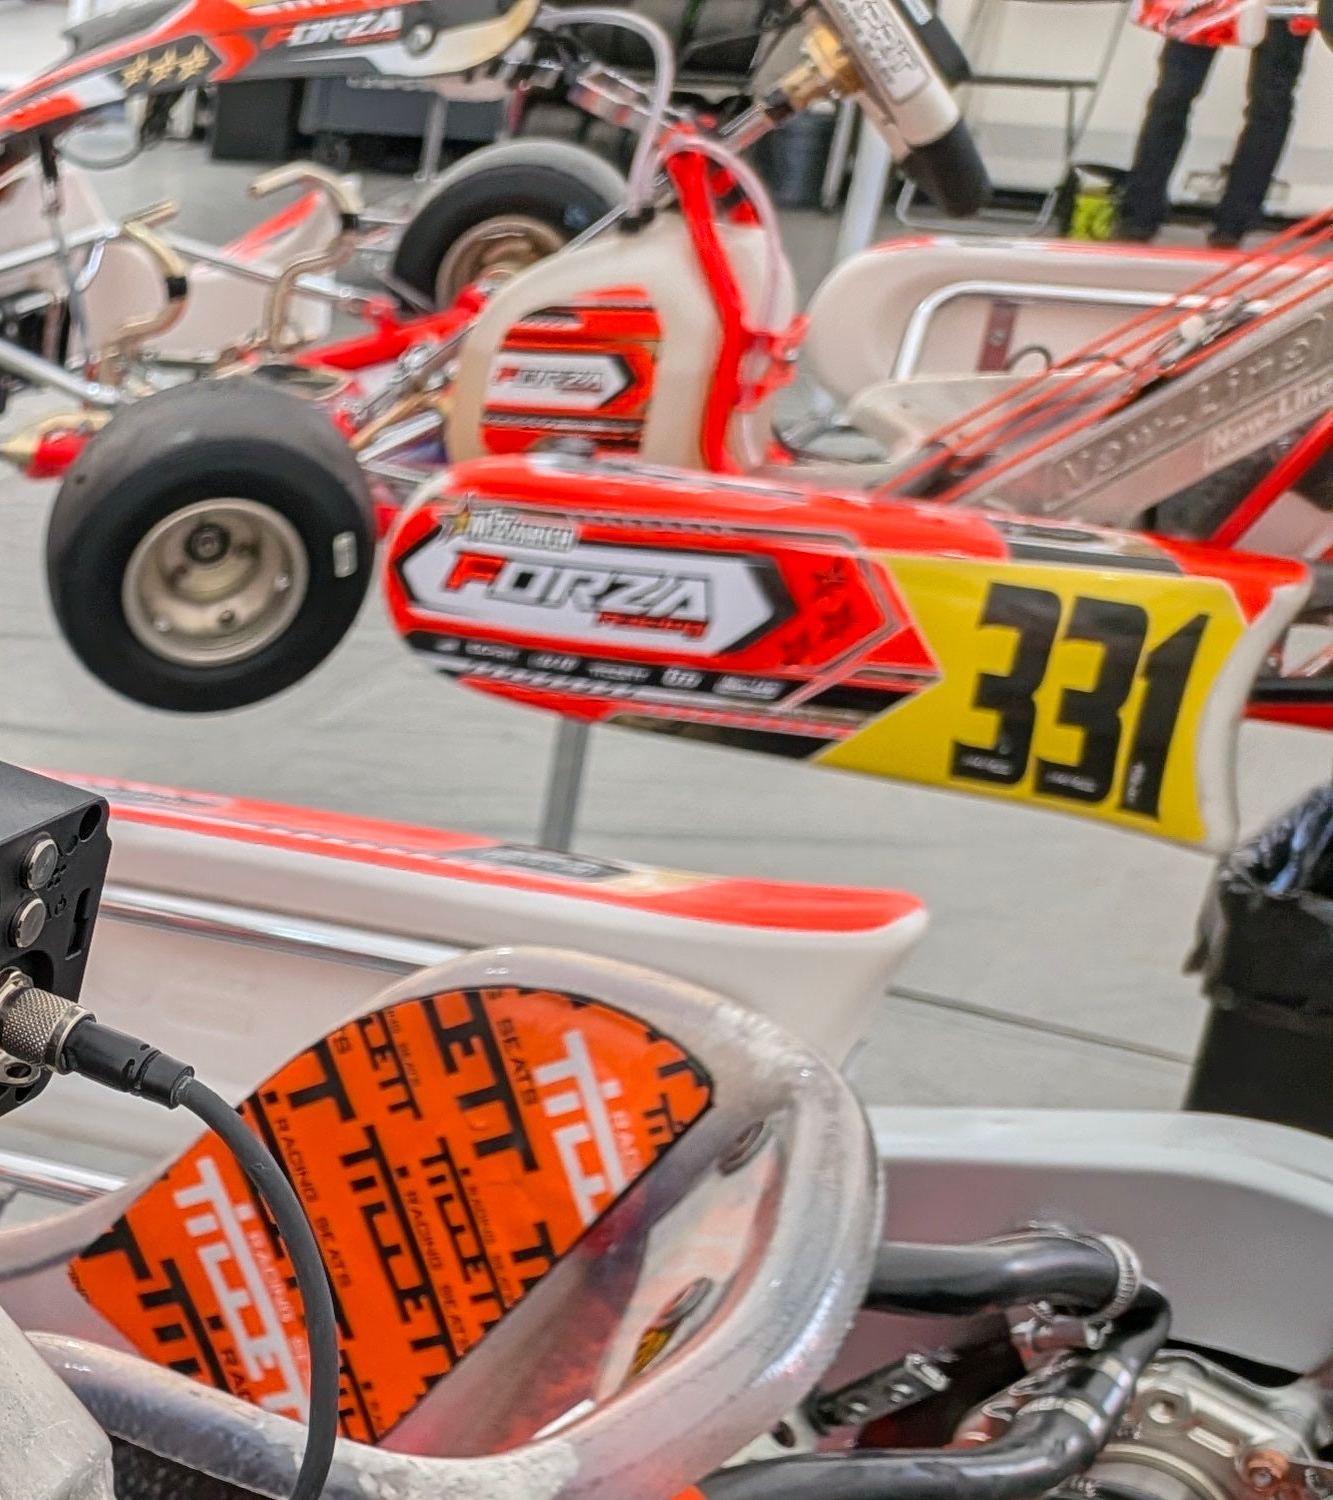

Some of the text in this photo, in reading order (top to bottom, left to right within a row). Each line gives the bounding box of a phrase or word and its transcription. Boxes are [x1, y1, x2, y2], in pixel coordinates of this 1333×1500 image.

[445, 551, 711, 619] FORZA
[949, 582, 1211, 821] 331
[276, 1117, 318, 1204] RACING
